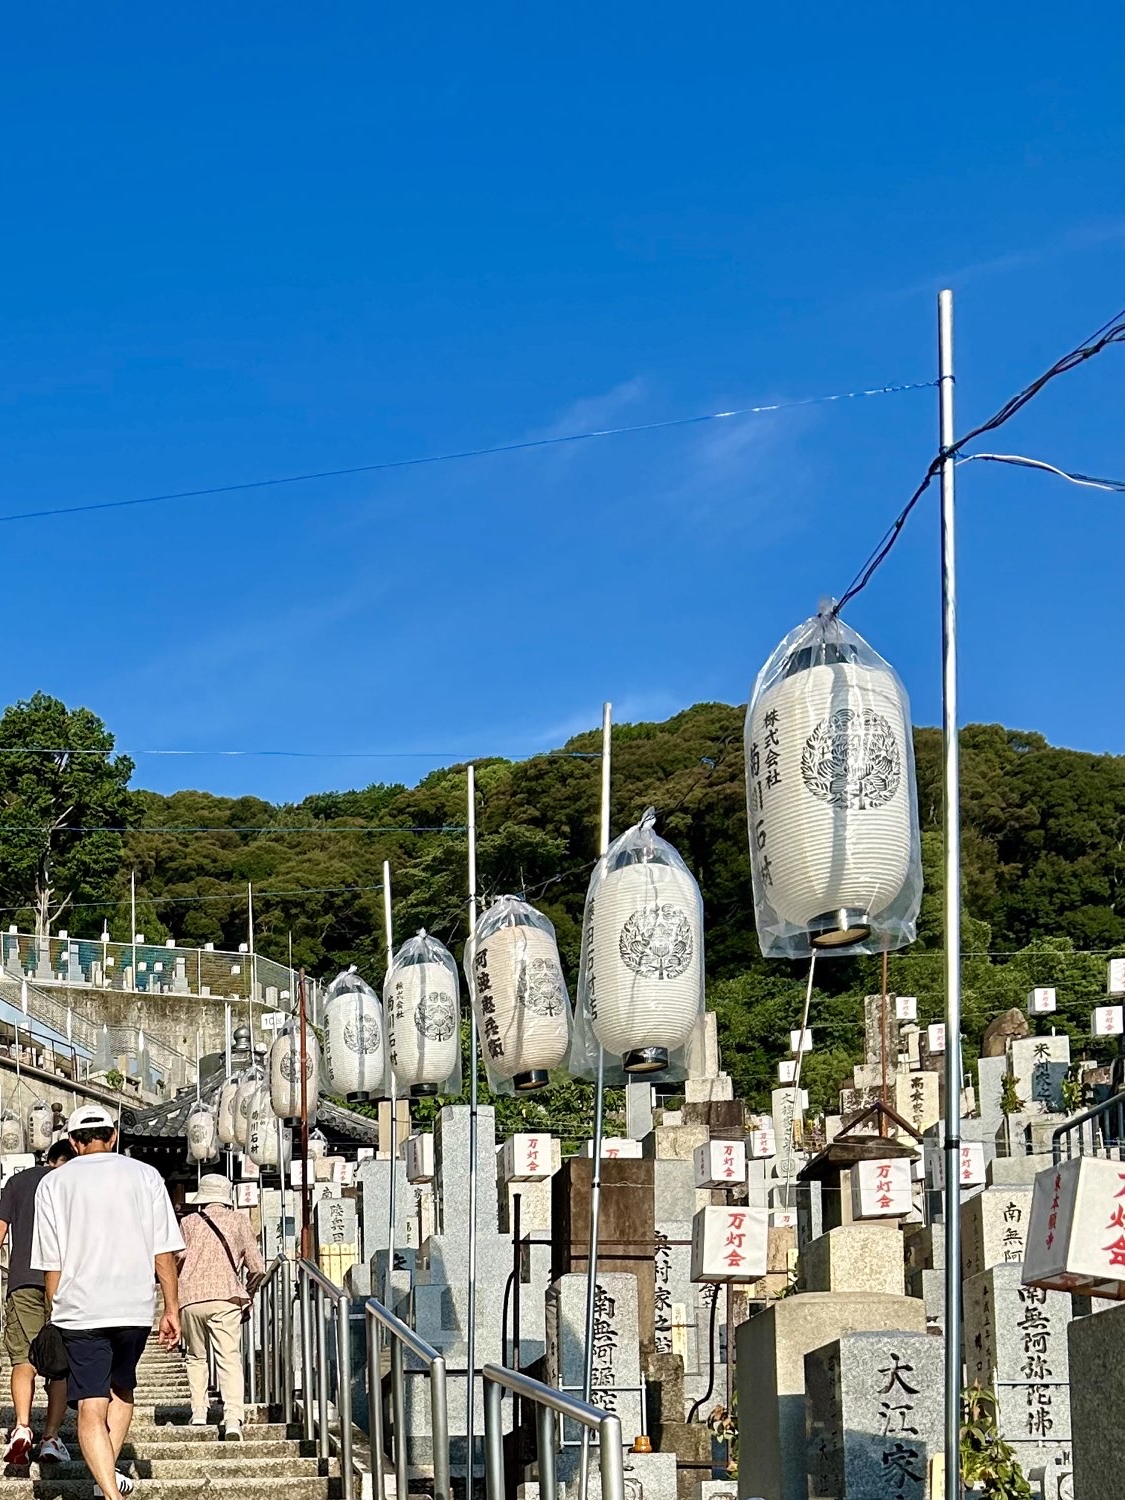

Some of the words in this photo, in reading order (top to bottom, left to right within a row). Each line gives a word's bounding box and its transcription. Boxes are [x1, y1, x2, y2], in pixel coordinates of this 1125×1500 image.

[763, 708, 782, 790] 株式会社
[526, 1138, 540, 1172] 万灯会
[723, 1145, 735, 1178] 万灯会
[961, 1147, 974, 1180] 万灯会
[876, 1164, 895, 1209] 万灯会
[1046, 1173, 1062, 1250] 東本願寺
[723, 1212, 747, 1267] 万灯会
[1016, 1285, 1054, 1438] 南無阿弥陀佛
